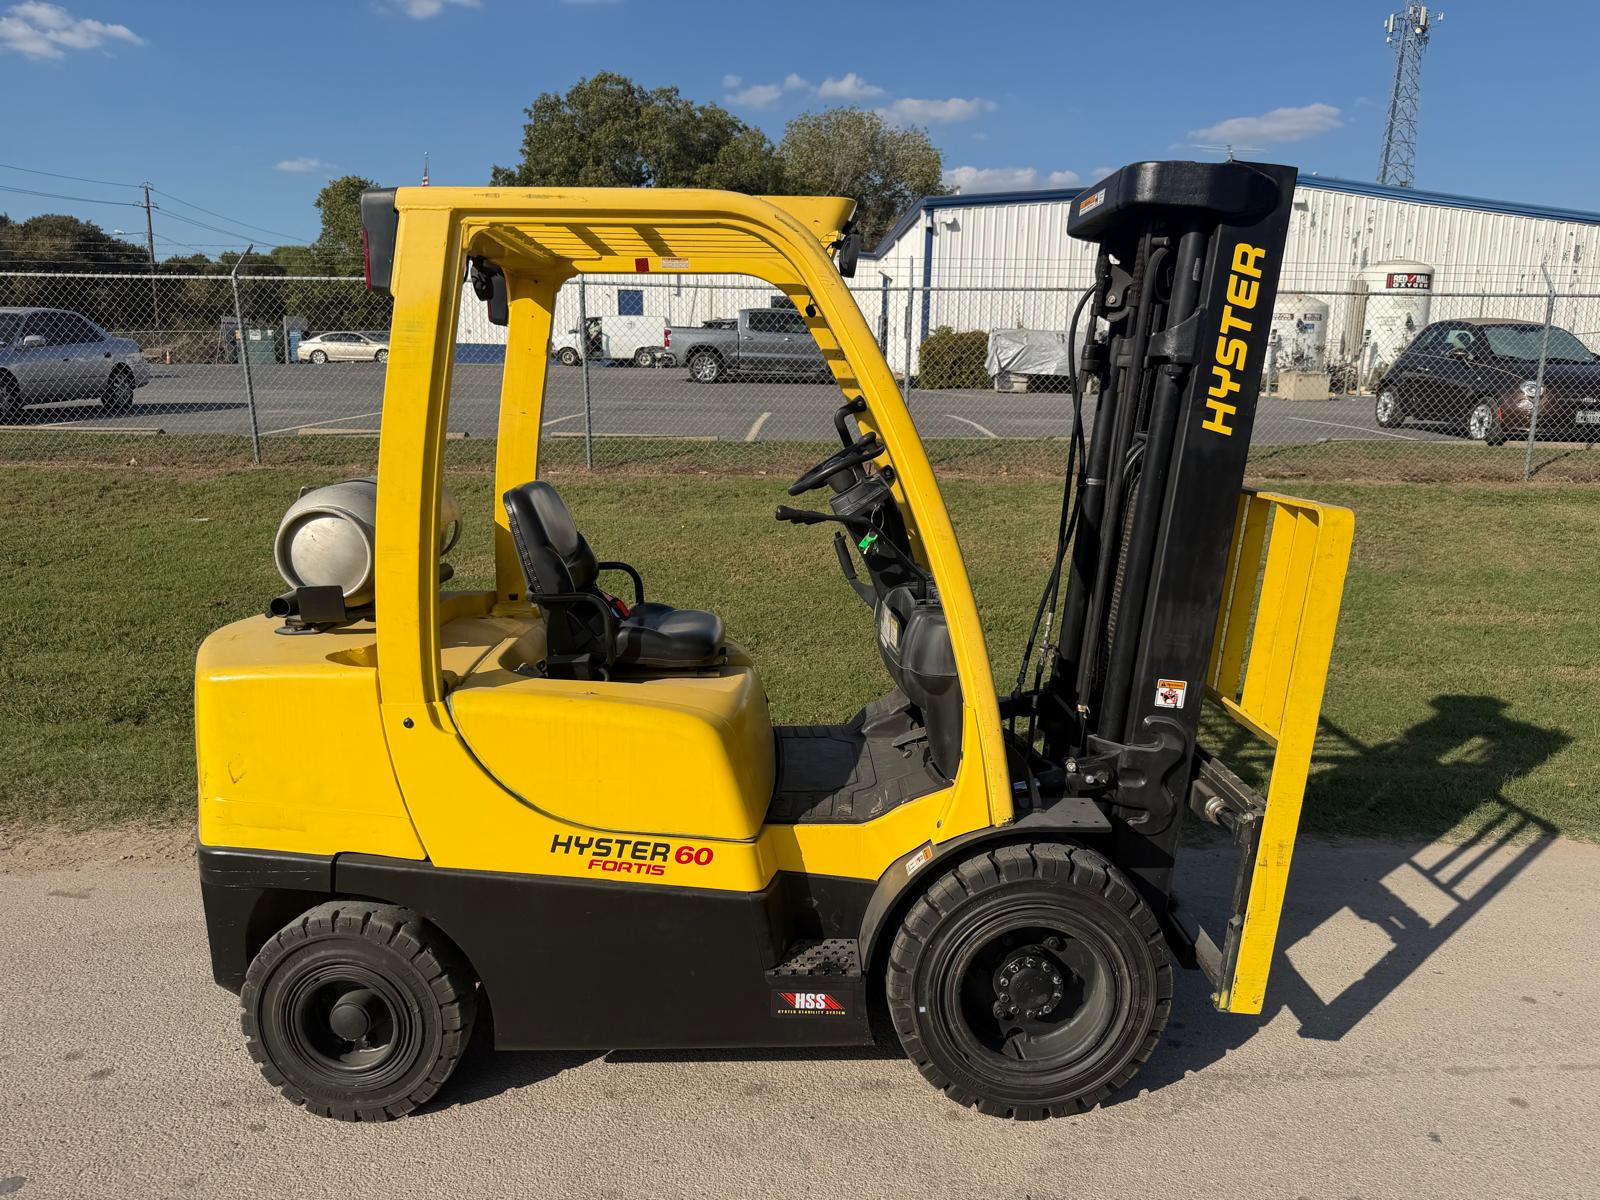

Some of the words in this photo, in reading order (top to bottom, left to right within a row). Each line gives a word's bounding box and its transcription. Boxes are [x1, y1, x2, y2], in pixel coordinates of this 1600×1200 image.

[1393, 274, 1408, 283] RED
[1201, 241, 1266, 436] HYSTER
[550, 834, 671, 862] HYSTER
[674, 845, 714, 866] 60
[587, 859, 666, 876] FORTIS
[795, 992, 826, 1009] HSS
